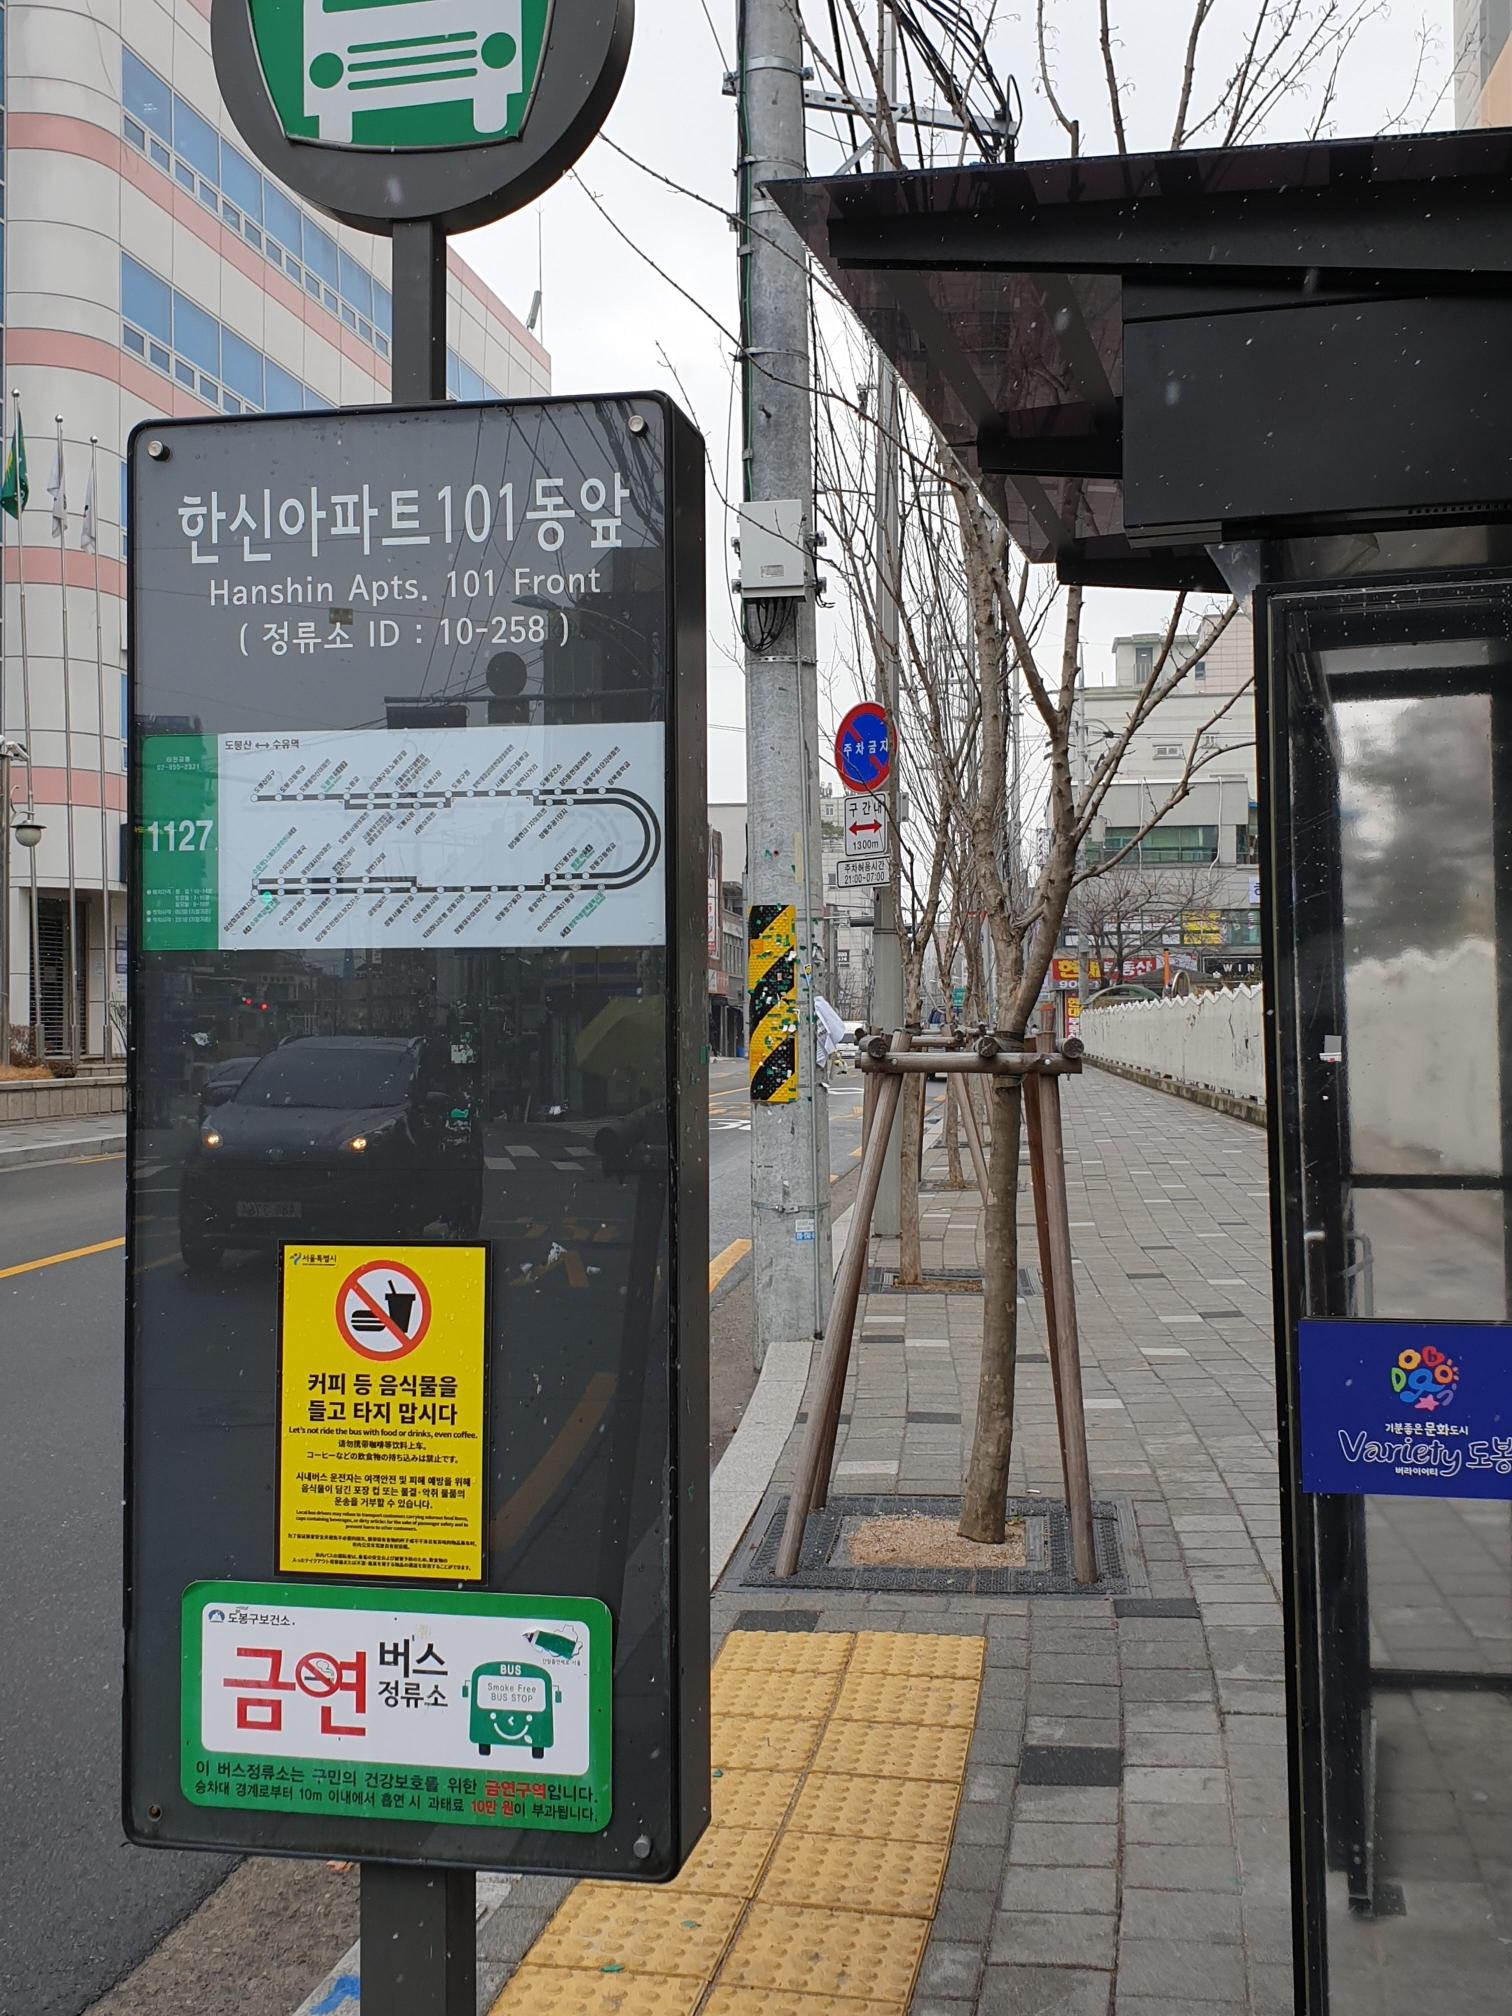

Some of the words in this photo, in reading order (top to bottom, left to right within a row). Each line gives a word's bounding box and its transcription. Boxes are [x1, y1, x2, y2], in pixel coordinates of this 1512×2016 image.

[178, 472, 630, 565] 한신아파트101동앞
[210, 574, 333, 606] Hanshin
[348, 572, 428, 603] Apts.
[447, 570, 495, 598] 101
[515, 567, 600, 596] Front
[263, 621, 353, 656] 정류소
[369, 620, 399, 648] ID
[440, 615, 546, 646] 10-258
[225, 740, 252, 751] 도봉산
[272, 738, 300, 750] 수유역
[148, 819, 214, 852] 1127
[853, 840, 878, 850] 1300m
[844, 861, 885, 873] 주차허용시간
[308, 1373, 345, 1395] 커피
[353, 1374, 372, 1396] 등
[379, 1374, 458, 1398] 음식물을
[308, 1400, 345, 1421] 들고
[353, 1401, 390, 1424] 타지
[399, 1402, 458, 1425] 맙시다
[288, 1426, 306, 1434] Let's
[320, 1427, 334, 1435] ride
[335, 1427, 347, 1435] the
[363, 1428, 379, 1436] with
[408, 1429, 433, 1438] drinks,
[1338, 1429, 1462, 1477] Variety
[1465, 1436, 1512, 1474] 도봉
[296, 1472, 327, 1481] 시내버스
[330, 1473, 362, 1483] 운전자는
[364, 1474, 396, 1484] 여객안전
[399, 1475, 406, 1484] 및
[410, 1476, 425, 1485] 피해
[428, 1476, 452, 1486] 예방을
[455, 1477, 471, 1487] 위해
[1395, 1466, 1438, 1477] 버라이어티
[301, 1483, 332, 1494] 음식물이
[335, 1485, 351, 1494] 담긴
[354, 1486, 369, 1495] 포장
[372, 1486, 379, 1495] 컵
[382, 1487, 398, 1496] 또는
[441, 1488, 465, 1499] 물품의
[334, 1497, 358, 1506] 운송을
[361, 1498, 384, 1507] 거부할
[387, 1499, 395, 1508] 수
[398, 1499, 432, 1509] 있습니다.
[500, 1664, 521, 1675] BUS
[223, 1647, 367, 1737] 금연
[378, 1638, 449, 1678] 버스
[377, 1680, 449, 1710] 정류소
[488, 1682, 514, 1692] Smoke
[518, 1684, 536, 1693] Free
[491, 1693, 507, 1701] BUS
[511, 1694, 533, 1703] STOP
[196, 1760, 209, 1776] 이
[218, 1762, 304, 1783] 버스정류소는
[312, 1768, 357, 1786] 구민의
[364, 1773, 439, 1791] 건강보호를
[448, 1777, 477, 1795] 위한
[485, 1779, 598, 1803] 금연구역입니다.
[195, 1779, 229, 1796] 승차대
[236, 1783, 293, 1801] 경계로부터
[299, 1788, 322, 1801] 10m
[329, 1789, 375, 1806] 이내에서
[381, 1793, 405, 1808] 흡연
[409, 1796, 421, 1809] 시
[429, 1796, 464, 1812] 과태료
[472, 1800, 496, 1815] 10만
[502, 1801, 526, 1817] 원이
[532, 1804, 597, 1822] 부과됩니다.
